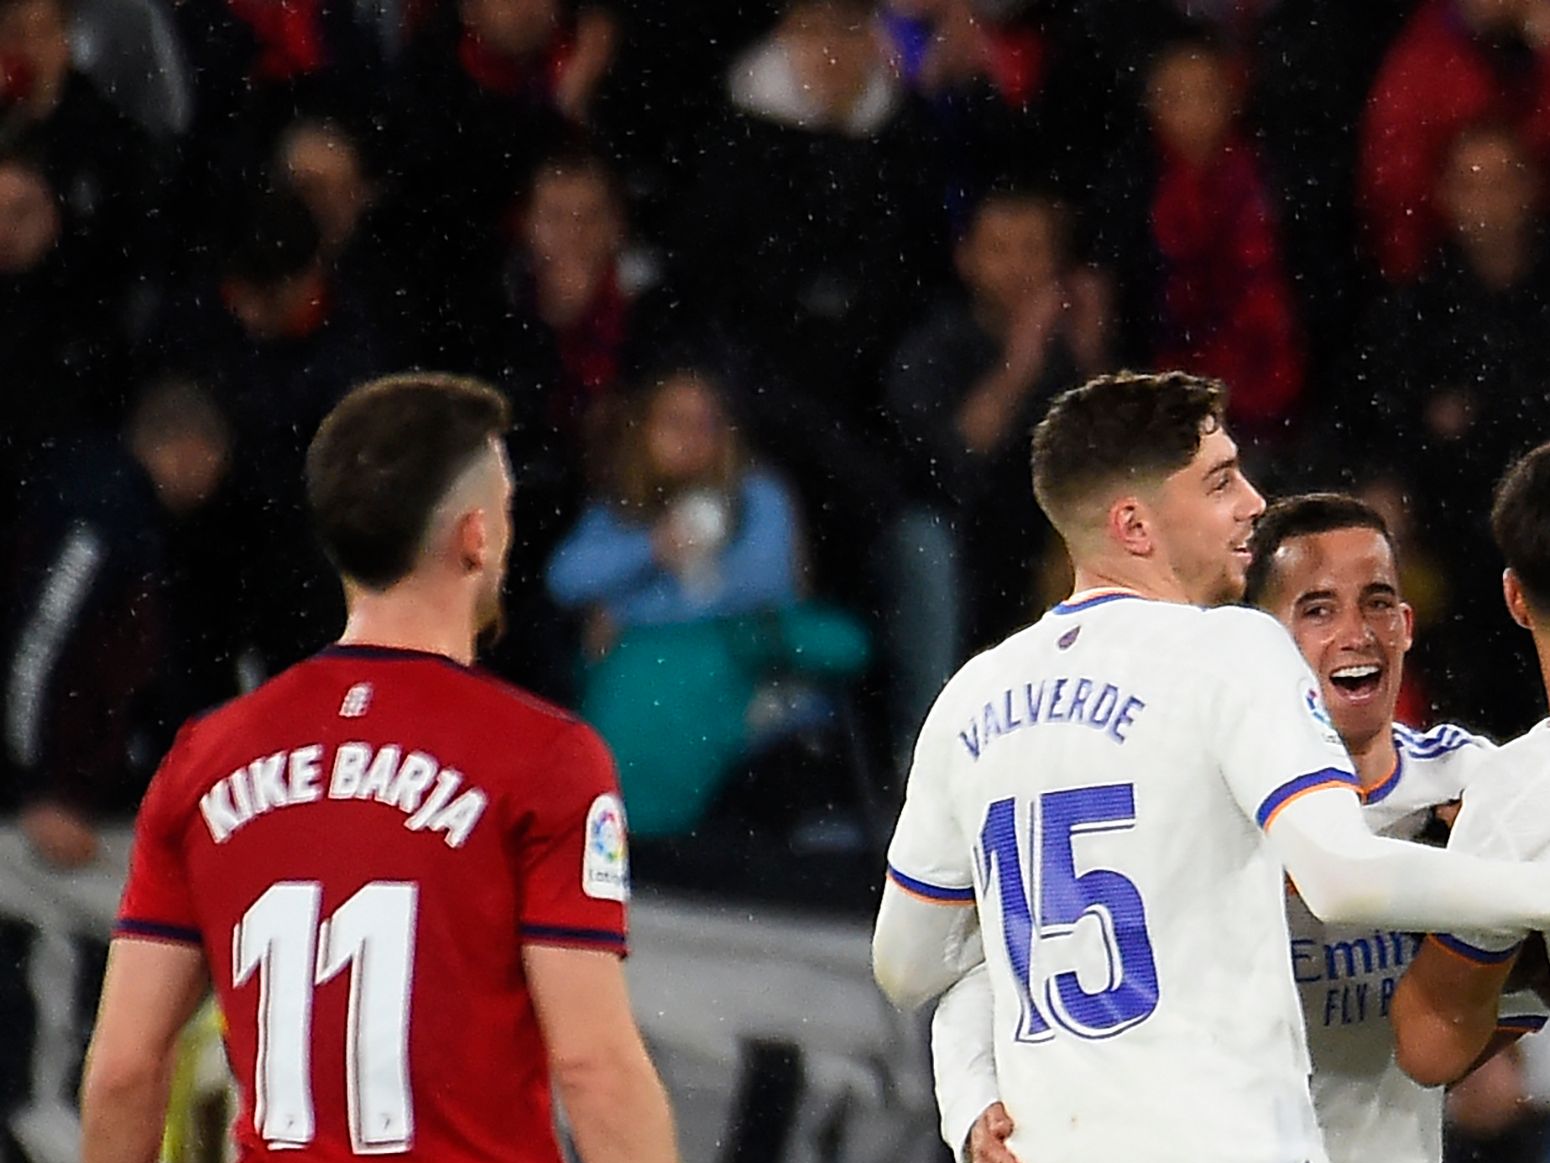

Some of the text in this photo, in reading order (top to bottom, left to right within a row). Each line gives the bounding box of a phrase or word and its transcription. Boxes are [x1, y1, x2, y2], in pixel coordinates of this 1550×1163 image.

[199, 741, 490, 848] KIKE BARJA
[959, 677, 1147, 763] VALVERDE
[972, 782, 1161, 1043] 15
[232, 881, 418, 1155] 11
